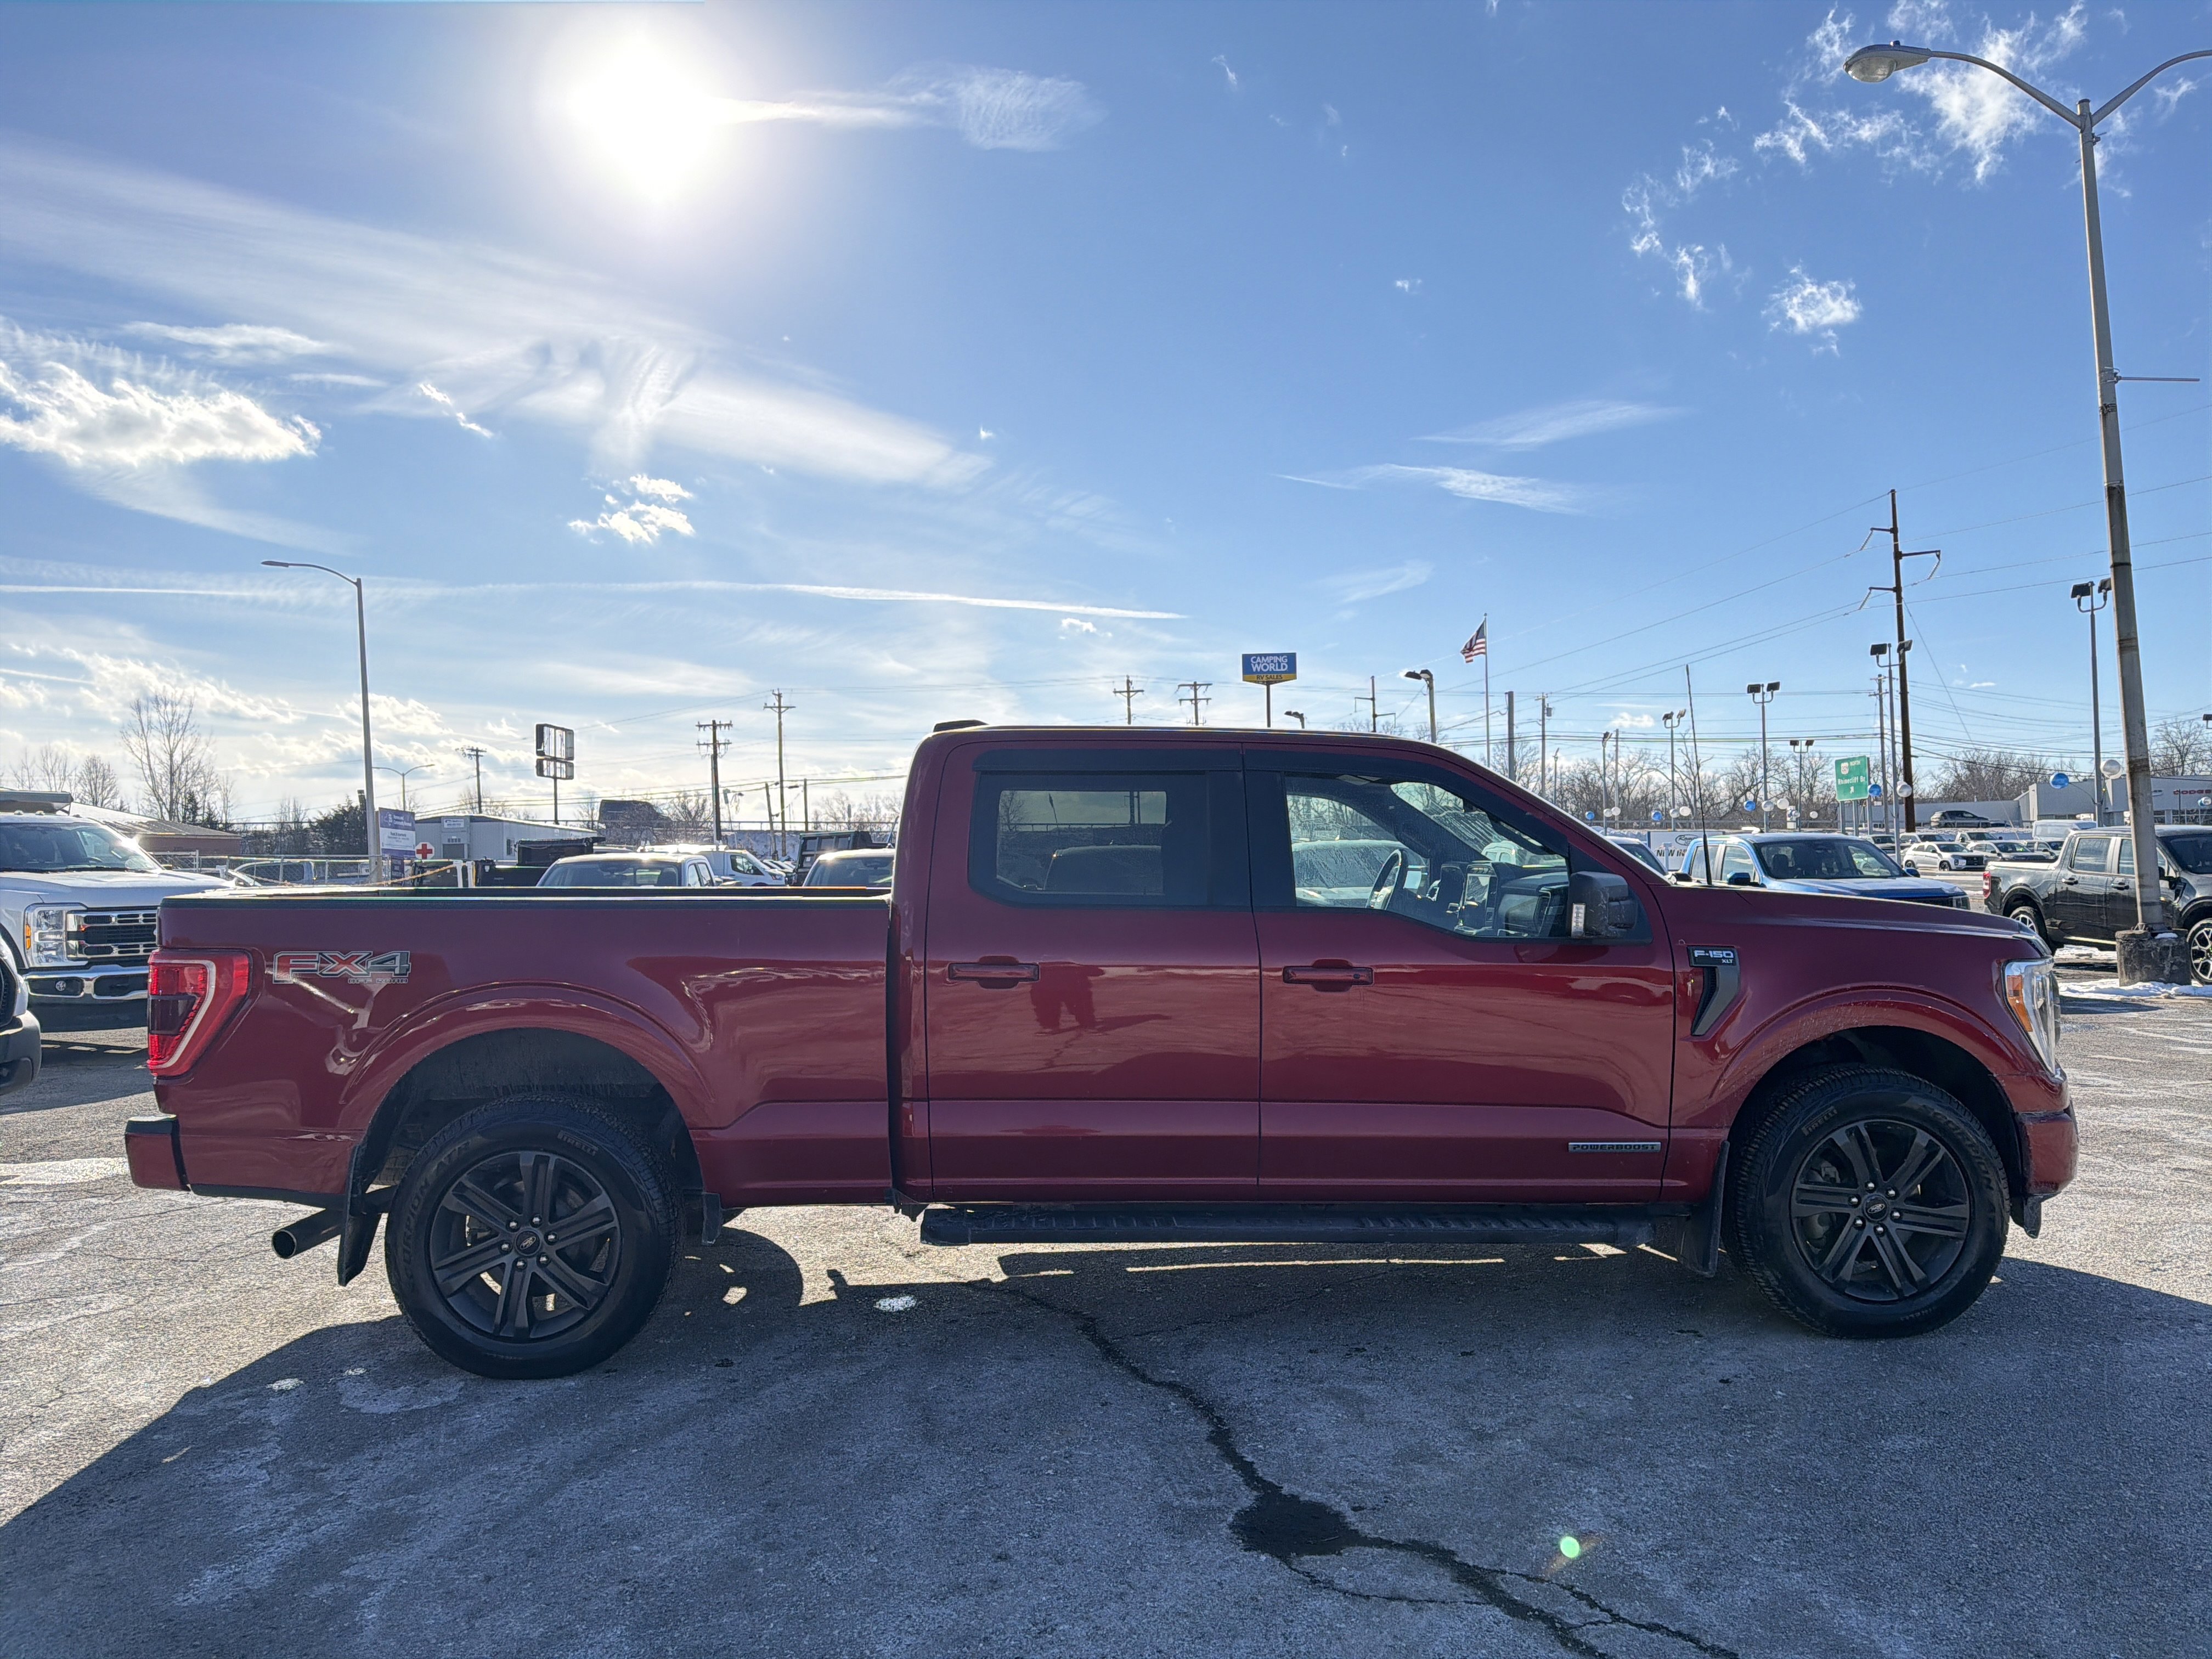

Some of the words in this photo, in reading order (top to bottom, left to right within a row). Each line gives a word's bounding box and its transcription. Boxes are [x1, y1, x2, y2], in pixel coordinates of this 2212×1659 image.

[1251, 663, 1288, 672] WORLD
[272, 950, 411, 984] FX4
[1694, 950, 1734, 958] F-150
[1801, 1105, 1838, 1136] PIRELLI
[557, 1130, 599, 1156] PIRELLI
